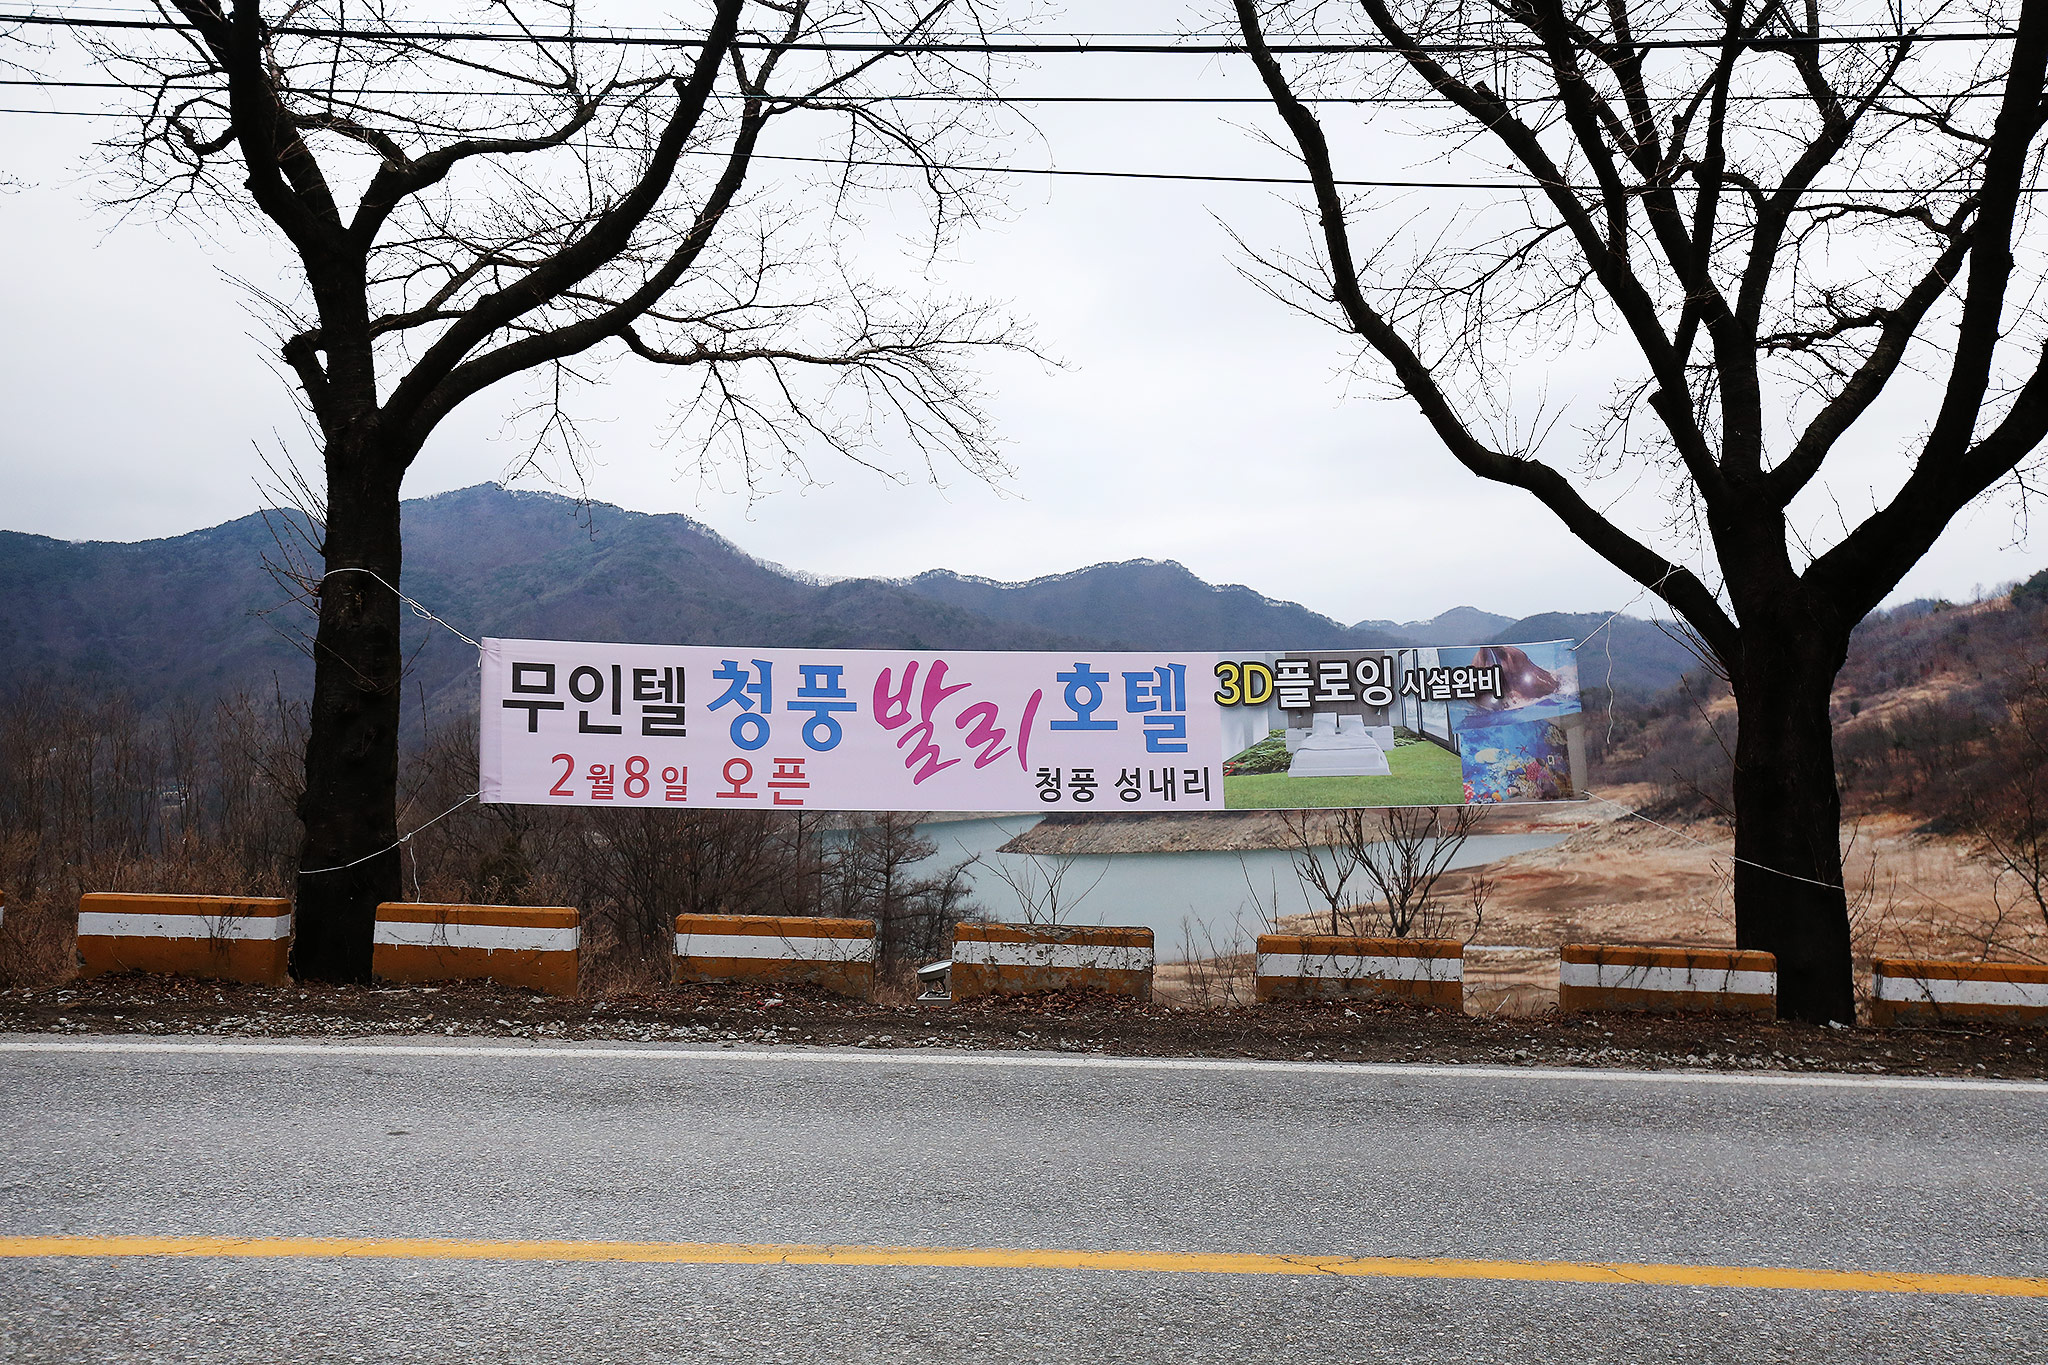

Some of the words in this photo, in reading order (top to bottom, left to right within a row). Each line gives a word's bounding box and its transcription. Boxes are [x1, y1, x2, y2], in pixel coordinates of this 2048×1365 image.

[1400, 665, 1504, 702] 시설완비
[502, 661, 687, 737] 무인텔
[706, 659, 858, 751] 청풍
[872, 659, 1043, 786] 발리
[1050, 662, 1189, 753] 호텔
[716, 757, 811, 806] 오픈
[1034, 766, 1099, 803] 청풍
[1114, 766, 1211, 803] 성내리
